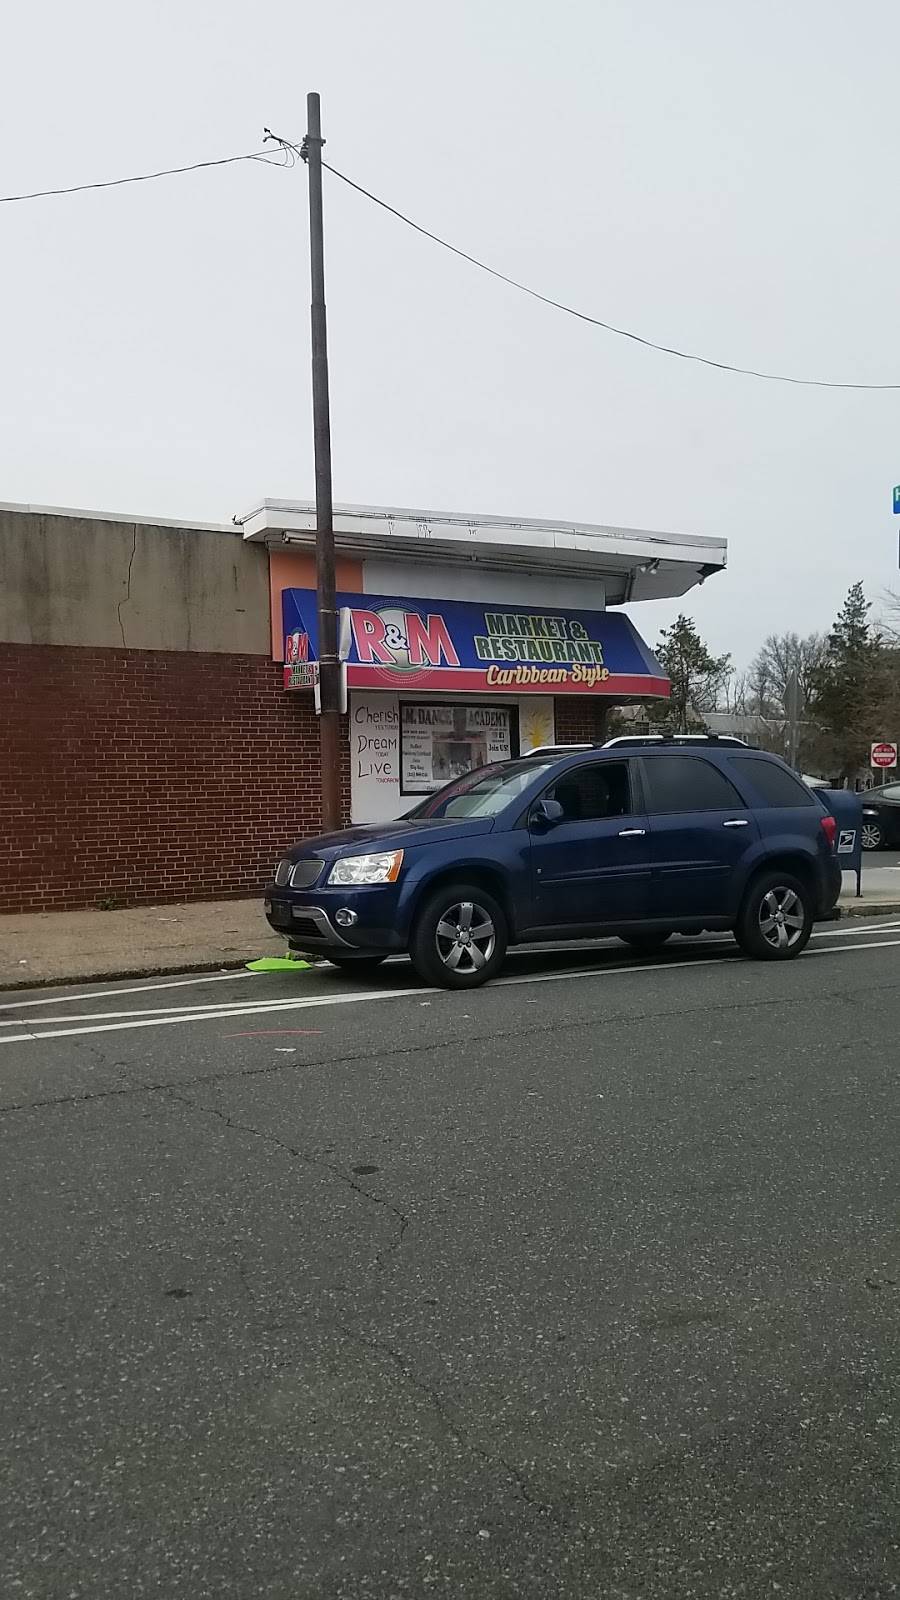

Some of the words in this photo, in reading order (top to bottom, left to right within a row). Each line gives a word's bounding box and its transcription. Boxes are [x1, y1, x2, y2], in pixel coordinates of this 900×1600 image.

[349, 609, 460, 666] R&M
[484, 612, 568, 640] MARKET
[569, 621, 589, 641] &
[286, 633, 308, 664] R&M
[474, 635, 604, 665] RESTAURANT
[486, 664, 568, 686] Caribbean
[570, 663, 610, 688] Style
[355, 706, 399, 724] Cherish
[418, 708, 452, 725] DAN
[469, 710, 509, 728] ACADEMY
